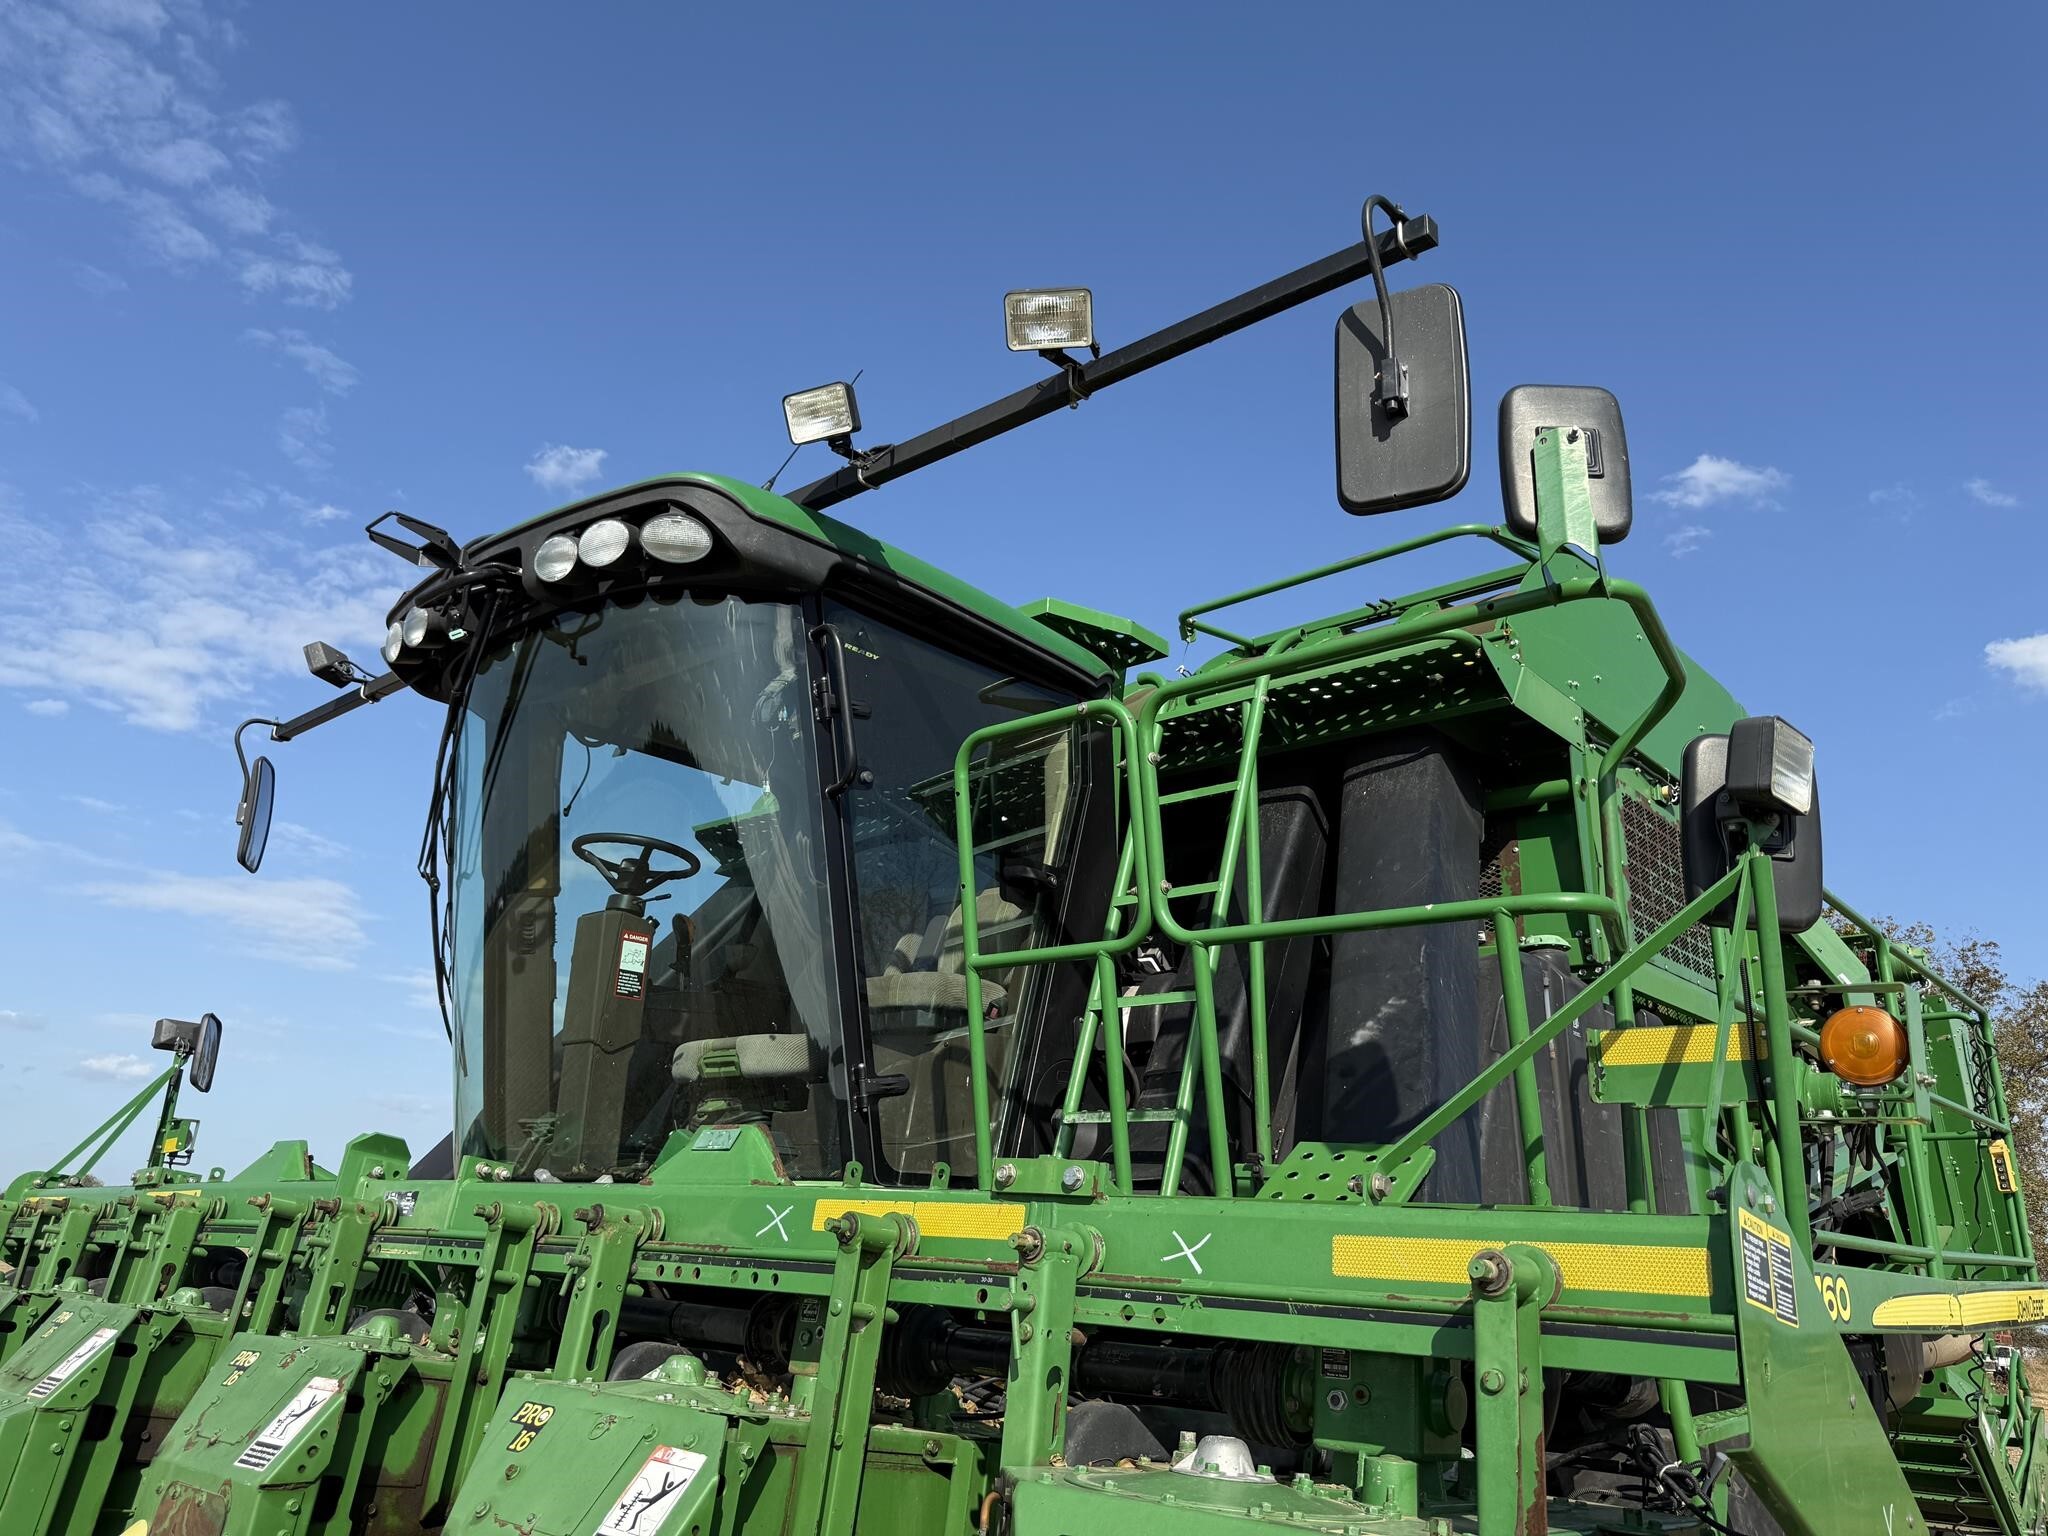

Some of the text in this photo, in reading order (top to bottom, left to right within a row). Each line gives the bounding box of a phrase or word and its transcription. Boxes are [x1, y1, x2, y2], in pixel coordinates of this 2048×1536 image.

[843, 642, 880, 660] READY
[629, 933, 649, 943] DANGER
[229, 1350, 261, 1368] PRO
[221, 1370, 245, 1386] 16
[510, 1402, 555, 1427] PRO
[507, 1430, 537, 1452] 16
